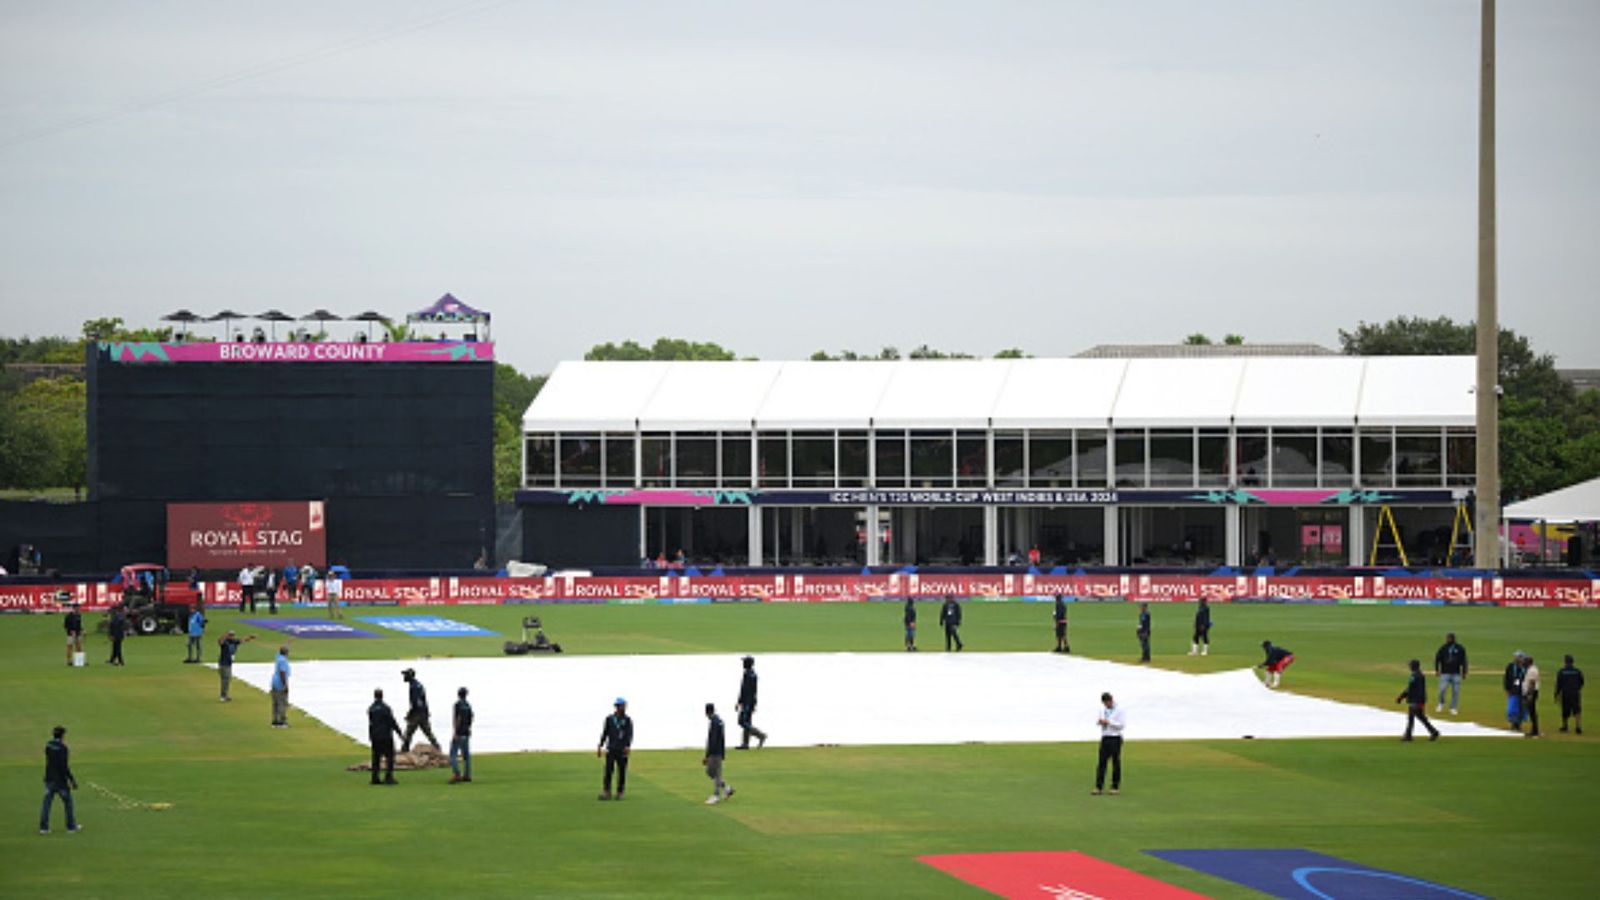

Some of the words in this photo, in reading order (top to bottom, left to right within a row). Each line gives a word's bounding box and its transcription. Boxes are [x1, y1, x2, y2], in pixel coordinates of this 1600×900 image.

[220, 344, 309, 360] BROWARD
[314, 344, 386, 360] COUNTY
[830, 492, 850, 502] ICC
[889, 492, 909, 502] T20
[910, 492, 952, 502] WORLD
[955, 492, 978, 502] CUP
[982, 492, 1013, 502] WEST
[1015, 492, 1054, 502] INDIES
[1064, 492, 1089, 502] USA
[1090, 492, 1118, 502] 2024
[190, 531, 252, 547] ROYAL
[256, 530, 303, 546] STAG
[344, 587, 391, 599] ROYAL
[460, 586, 505, 598] ROYAL
[576, 585, 619, 597] ROYAL
[691, 584, 736, 596] ROYAL
[804, 584, 851, 595] ROYAL
[921, 584, 965, 595] ROYAL
[1035, 584, 1078, 595] ROYAL
[1151, 585, 1198, 596] ROYAL
[1268, 586, 1312, 598] ROYAL
[1386, 586, 1431, 598] ROYAL
[1504, 587, 1551, 600] ROYAL
[0, 592, 35, 607] OYAL
